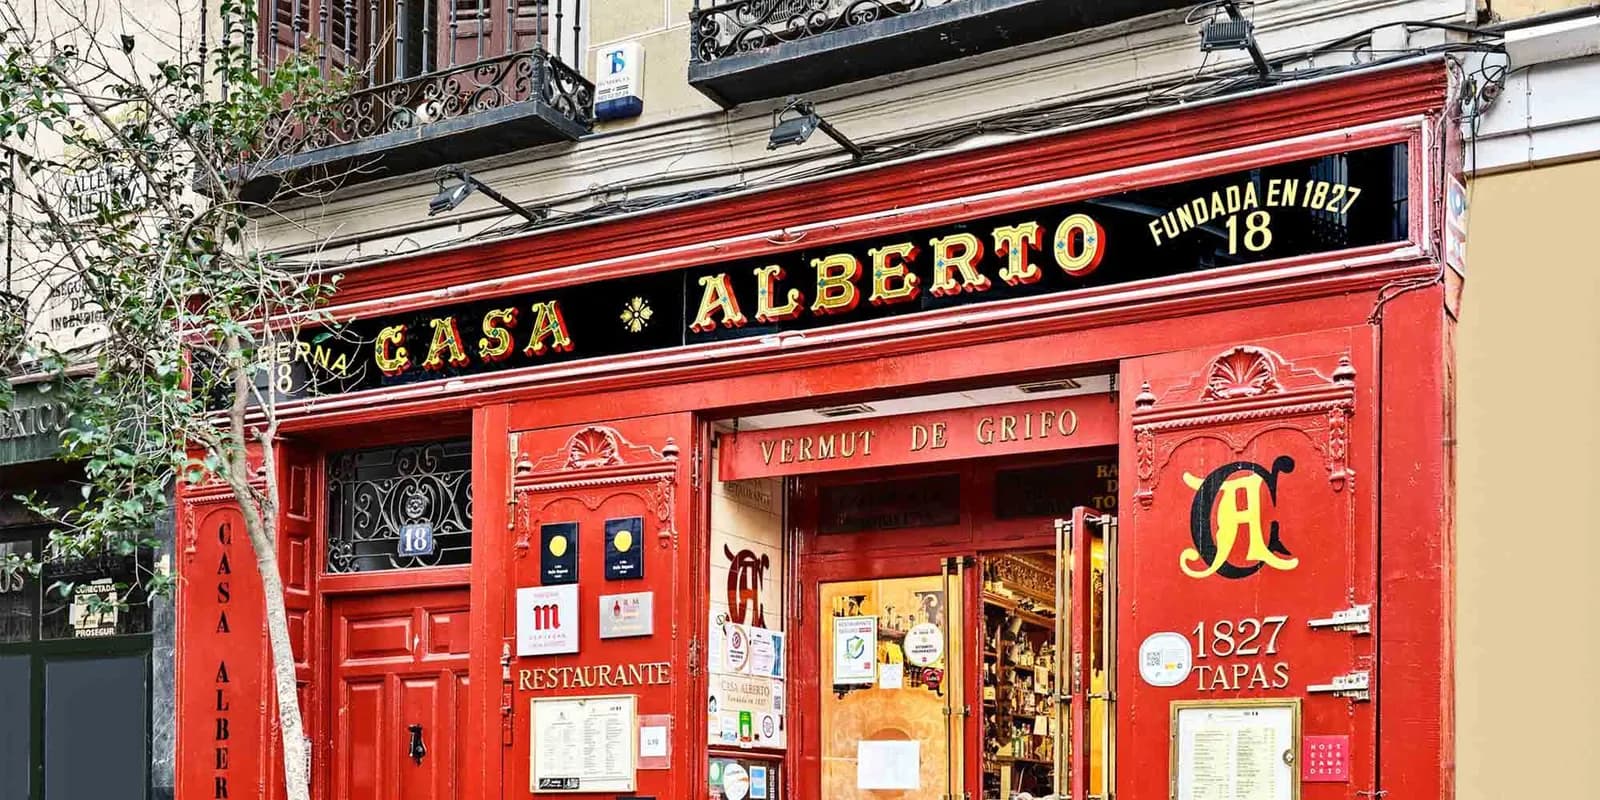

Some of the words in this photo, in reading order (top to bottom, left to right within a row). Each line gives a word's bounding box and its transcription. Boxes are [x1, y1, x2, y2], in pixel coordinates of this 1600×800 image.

[1148, 181, 1259, 247] FUNDADA
[1266, 178, 1299, 207] EN
[1302, 179, 1362, 215] 1827
[1225, 210, 1273, 255] 18
[374, 299, 575, 378] CASA
[689, 212, 1106, 334] ALBERTO
[760, 429, 876, 466] VERMUT
[910, 422, 948, 452] DE
[976, 408, 1079, 445] GRIFO
[405, 527, 427, 552] 18
[215, 521, 232, 633] CASA
[75, 627, 115, 638] PROSEGUR
[1192, 615, 1289, 658] 1827
[519, 662, 671, 690] RESTAURANTE
[1192, 662, 1290, 691] TAPAS
[215, 660, 230, 800] ALBER
